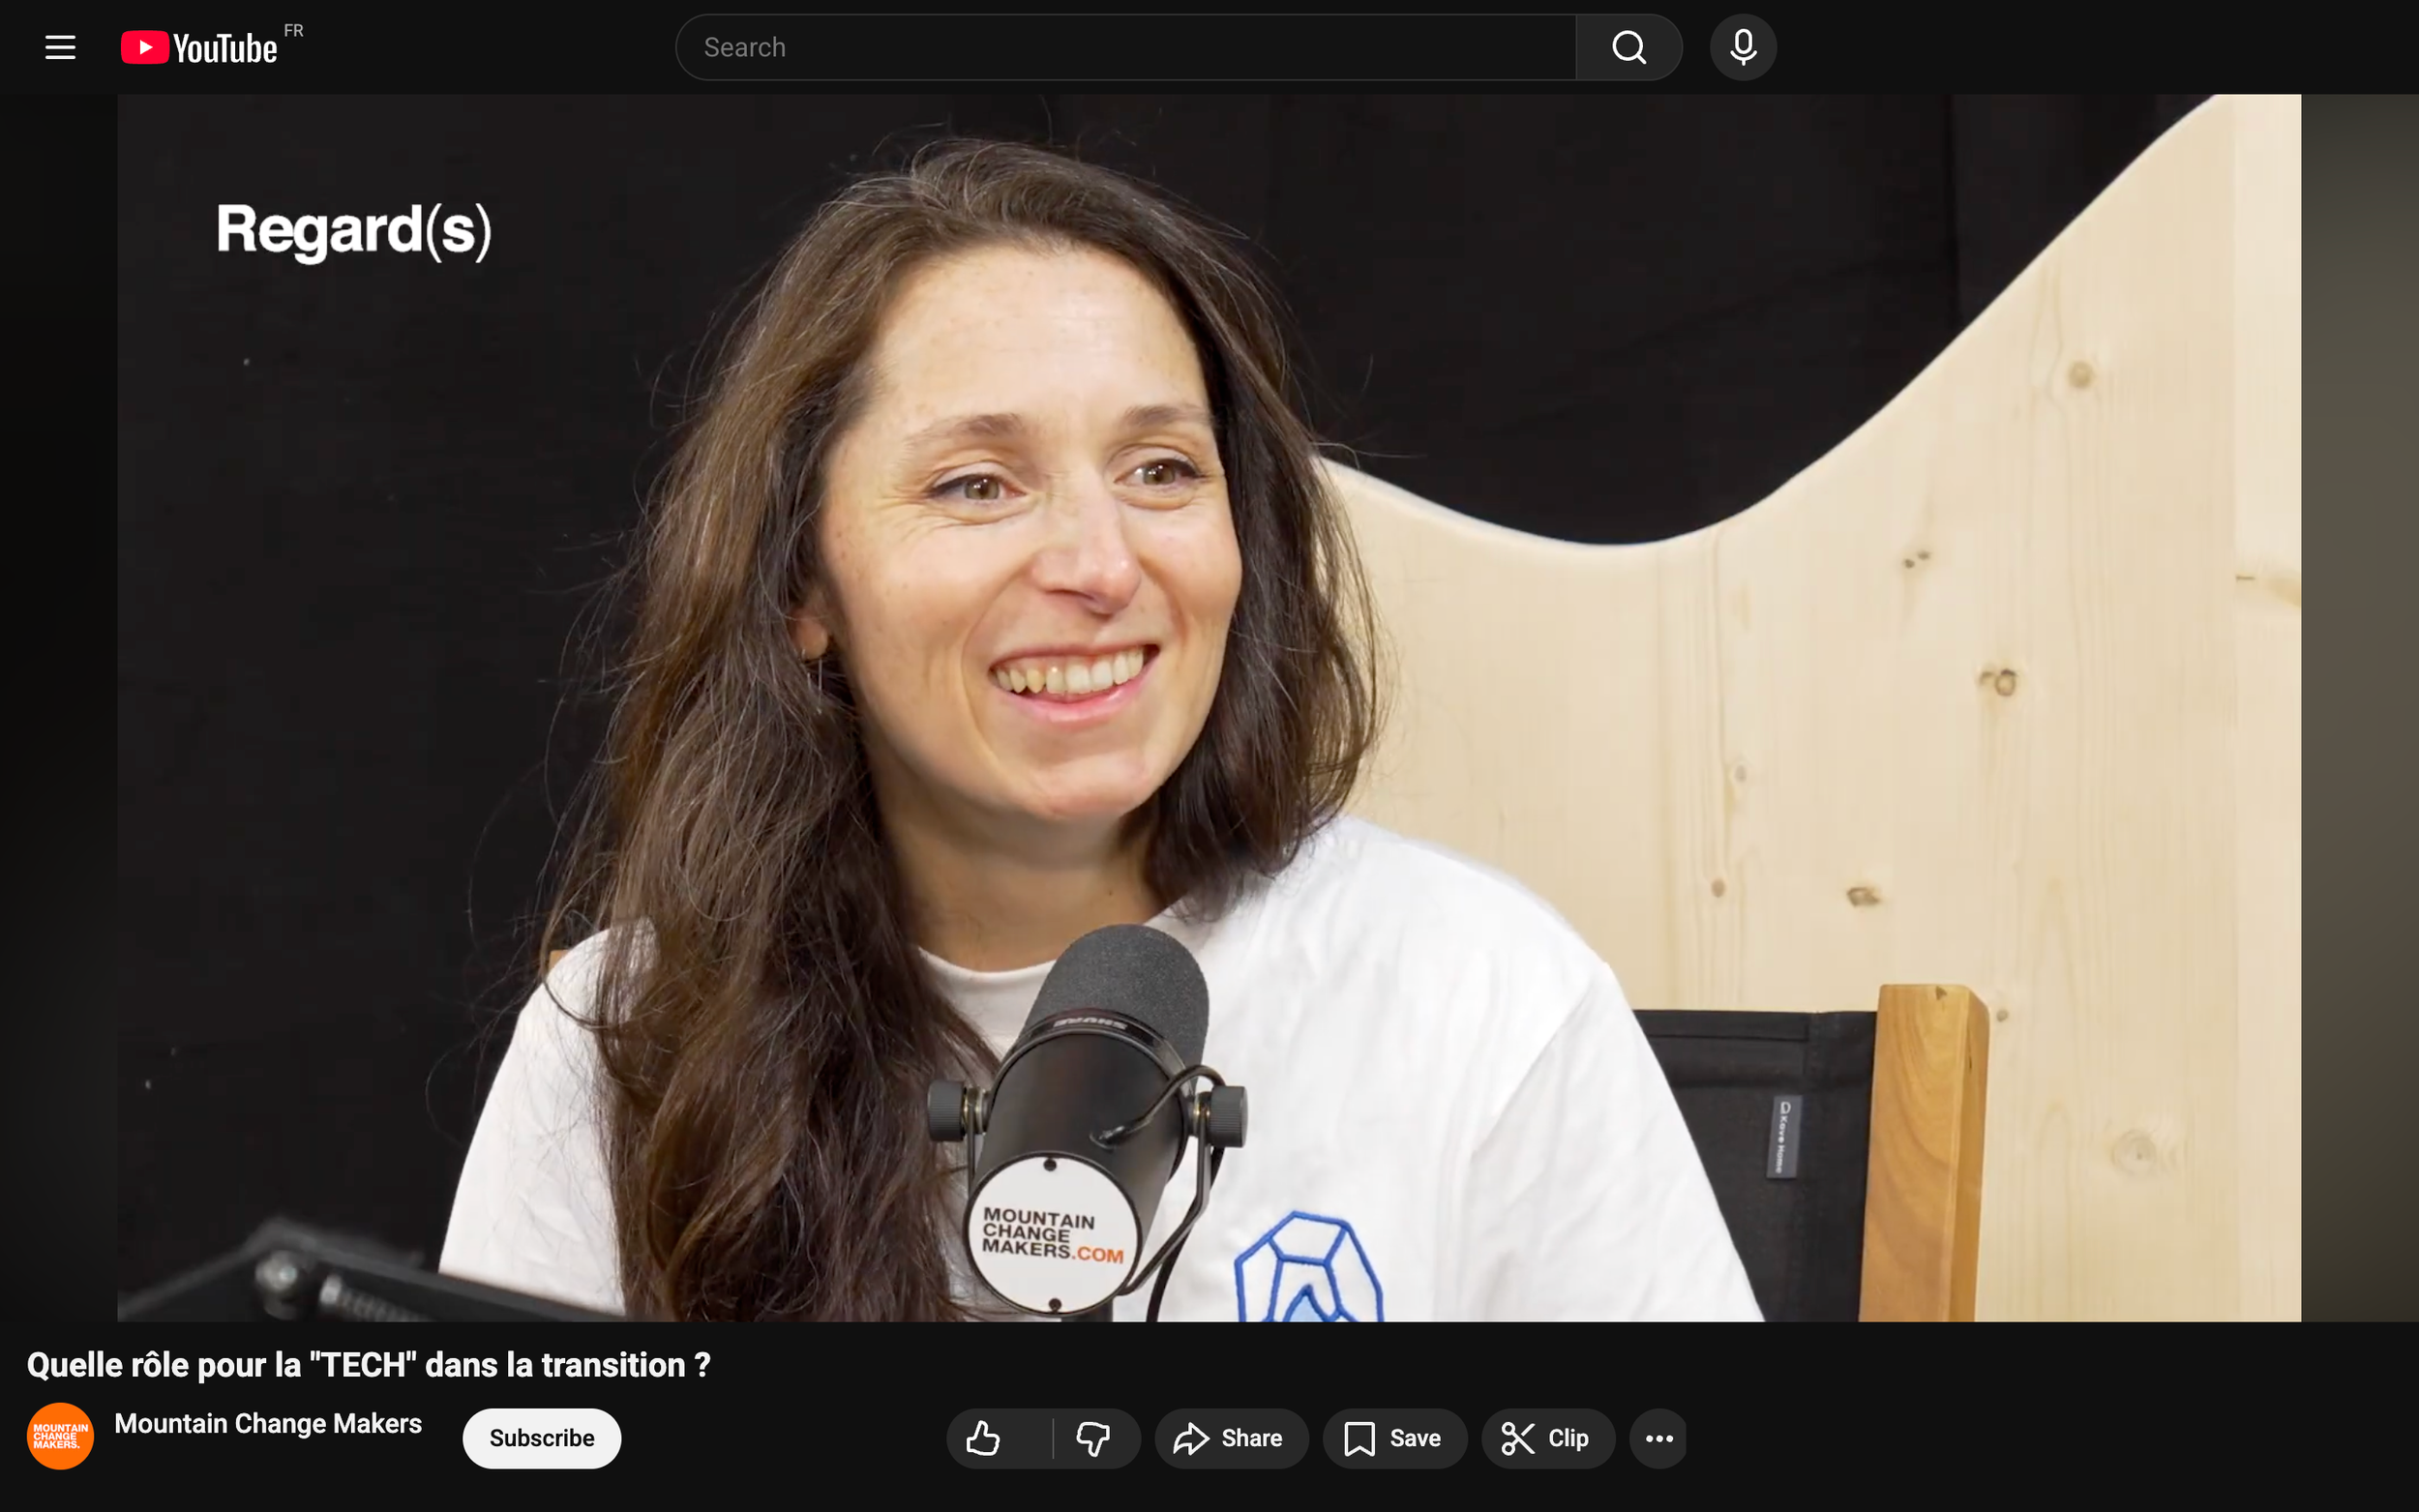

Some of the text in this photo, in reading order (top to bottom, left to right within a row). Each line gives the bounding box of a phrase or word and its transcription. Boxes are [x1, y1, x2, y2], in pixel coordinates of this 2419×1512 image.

[284, 23, 304, 37] FR
[172, 33, 278, 63] YouTube
[704, 36, 786, 57] Search
[1776, 1144, 1785, 1173] Home
[983, 1206, 1095, 1230] MOUNTAIN
[983, 1223, 1070, 1243] CHANGE
[982, 1238, 1123, 1264] MAKERS.COM
[27, 1350, 711, 1383] Quelle rôle pour la "TECH" dans la transition ?
[114, 1411, 423, 1438] Mountain Change Makers
[33, 1440, 80, 1449] MAKERS.
[491, 1428, 595, 1447] Subscribe
[1222, 1428, 1283, 1447] Share
[1389, 1428, 1442, 1447] Save
[1548, 1428, 1590, 1452] Clip
